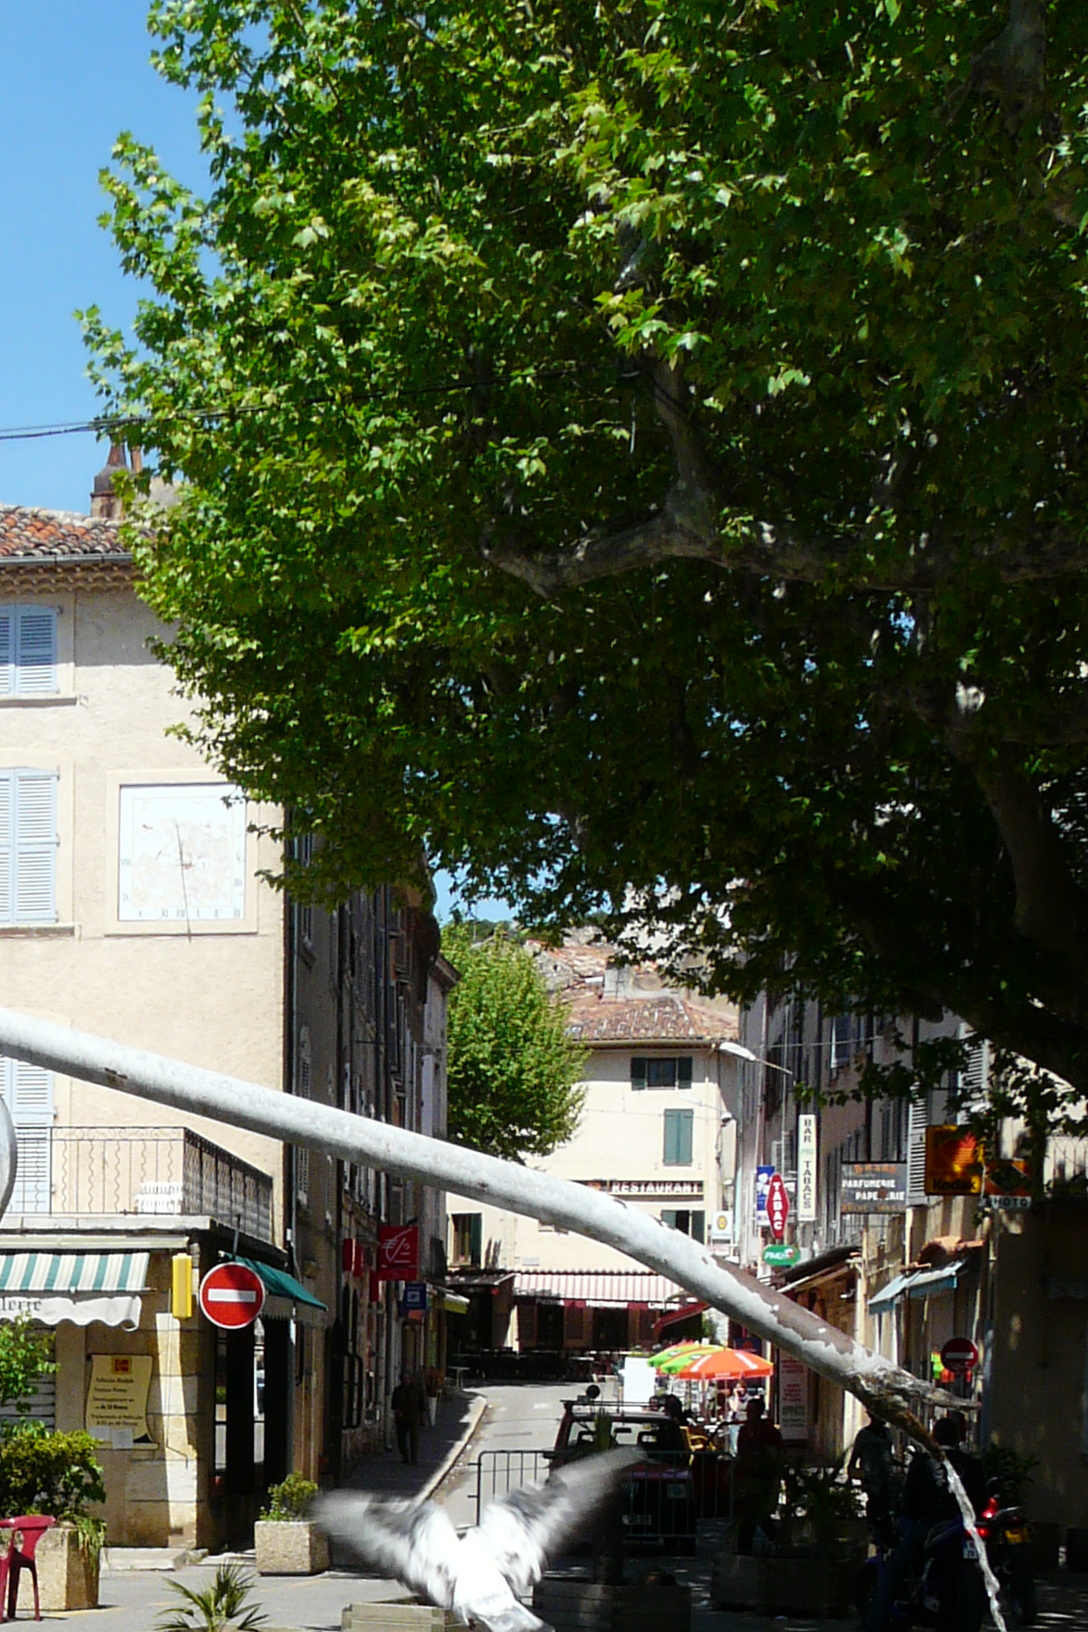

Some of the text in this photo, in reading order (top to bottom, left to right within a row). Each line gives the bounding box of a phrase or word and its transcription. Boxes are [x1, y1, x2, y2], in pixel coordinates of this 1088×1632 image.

[803, 1118, 812, 1143] BAR
[611, 1181, 700, 1193] RESTAURANT
[802, 1160, 812, 1209] TABACS
[841, 1179, 896, 1188] PARFUMERIE
[933, 1177, 978, 1191] Kodak
[855, 1191, 905, 1201] PAPERIE
[772, 1181, 783, 1230] TABAC
[763, 1251, 784, 1260] PMU
